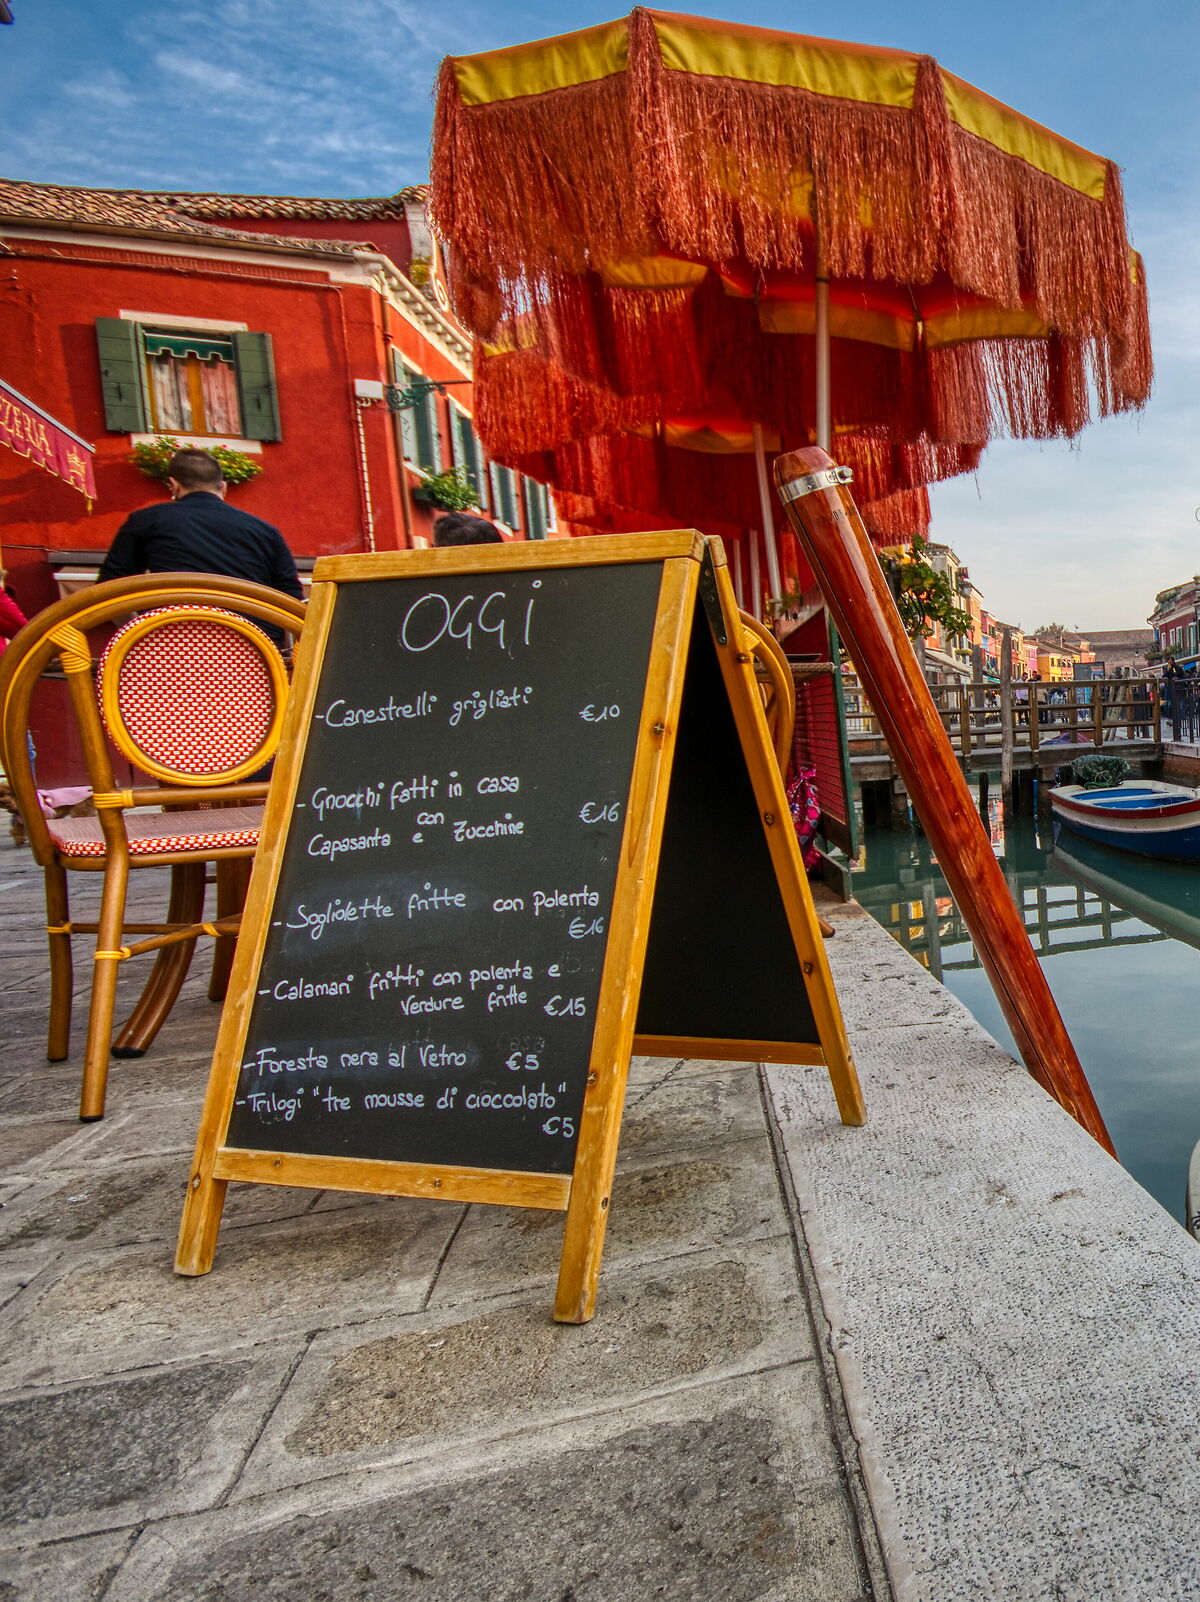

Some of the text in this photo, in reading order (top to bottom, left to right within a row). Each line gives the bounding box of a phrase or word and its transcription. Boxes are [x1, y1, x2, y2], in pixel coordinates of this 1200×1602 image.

[450, 687, 532, 726] grigliati
[579, 704, 620, 722] €10
[391, 775, 438, 810] fatti
[449, 771, 462, 797] in
[477, 776, 519, 794] casa
[417, 812, 444, 825] con
[579, 802, 620, 823] €16
[308, 827, 391, 861] Capasanta
[412, 832, 423, 843] e
[408, 882, 466, 917] fritte
[493, 898, 524, 912] con
[568, 917, 603, 938] €16
[369, 964, 425, 1000] fritti
[433, 972, 461, 986] con
[548, 964, 560, 977] e
[488, 984, 527, 1012] fritte
[544, 995, 585, 1016] €15
[340, 1052, 378, 1067] nera
[388, 1045, 406, 1060] al
[506, 1052, 539, 1070] €5
[365, 1093, 424, 1109] mousse
[437, 1087, 457, 1109] di
[543, 1117, 574, 1137] €5
